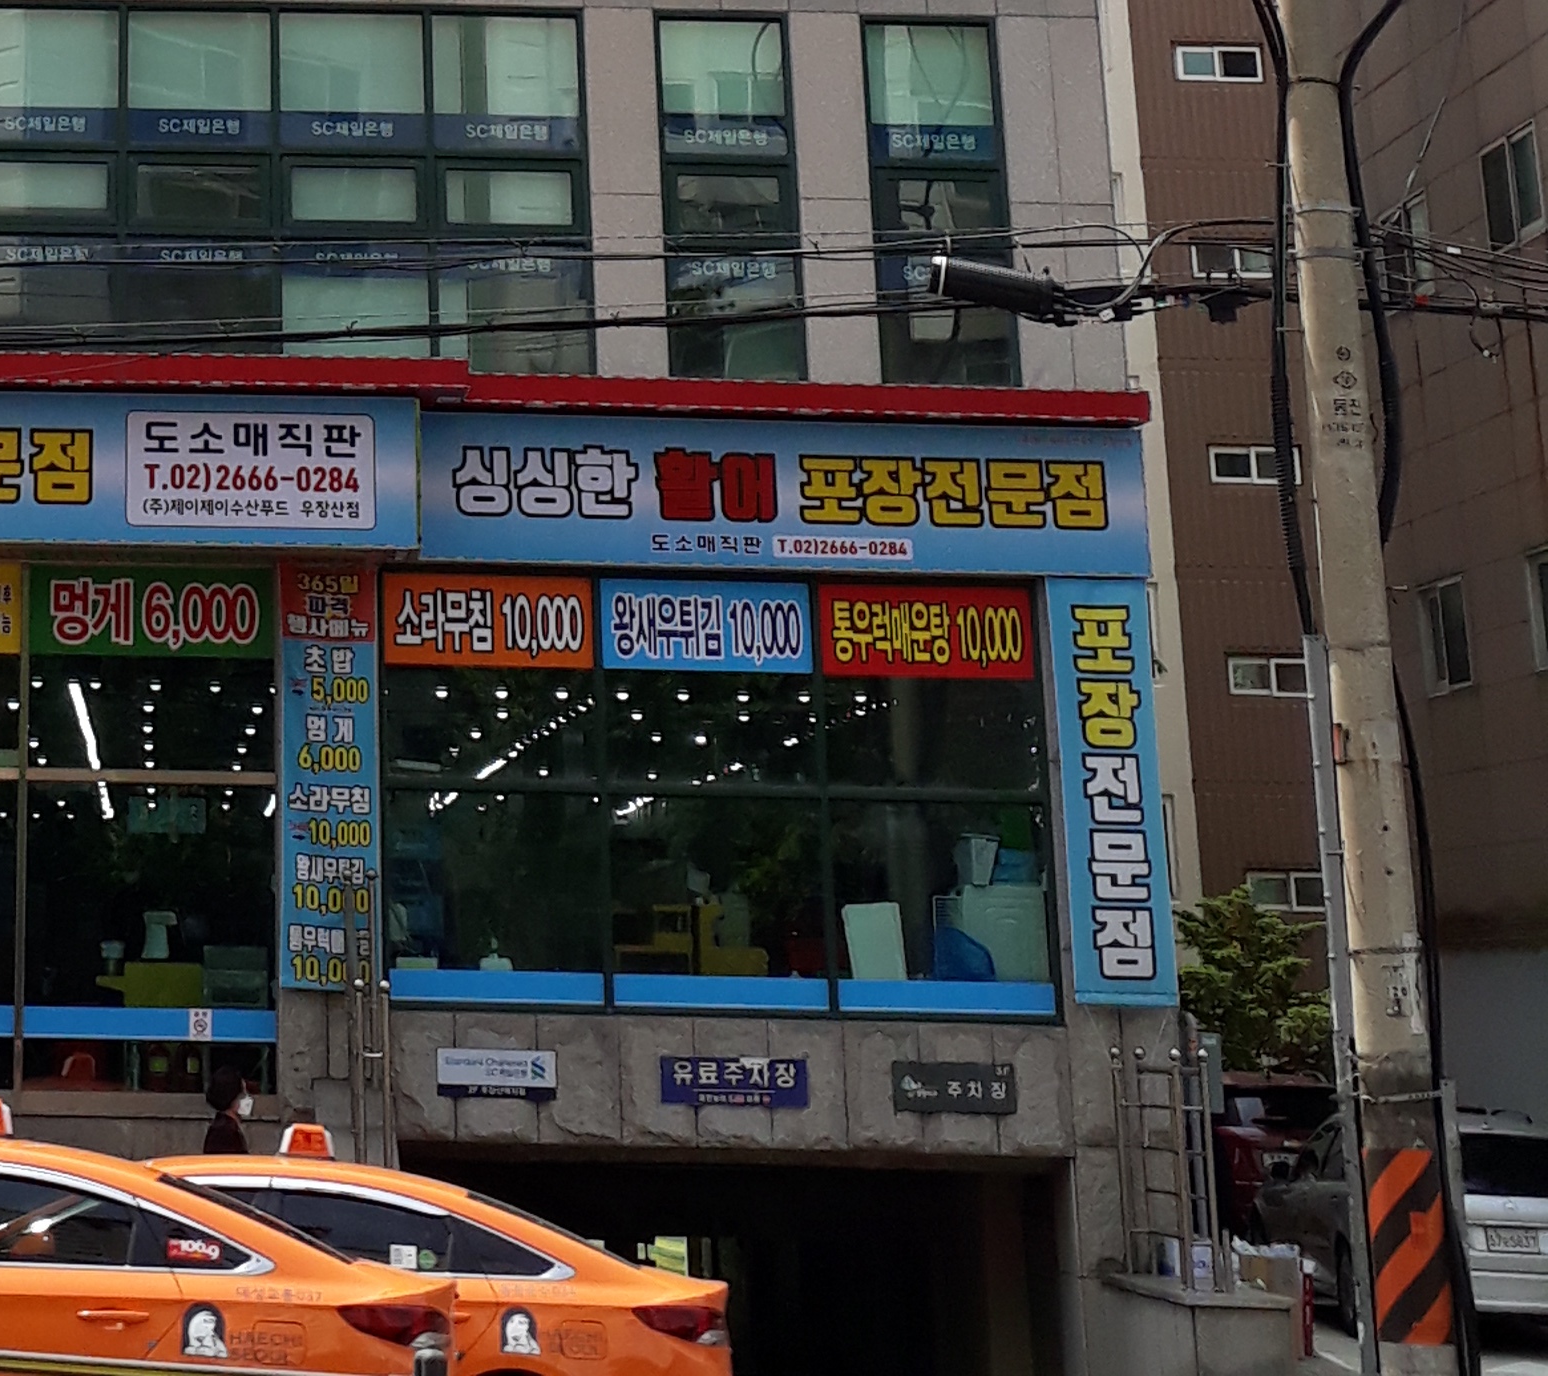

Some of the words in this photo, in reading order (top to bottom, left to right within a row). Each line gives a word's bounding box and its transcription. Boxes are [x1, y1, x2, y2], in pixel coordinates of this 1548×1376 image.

[4, 116, 87, 133] SC제일은행
[158, 117, 241, 134] SC제일은행
[310, 121, 394, 139] SC제일은행
[464, 123, 549, 141] SC제일은행
[683, 128, 770, 146] SC제일은행
[891, 132, 977, 151] SC제일은행
[144, 421, 363, 459] 도소매직판
[144, 462, 360, 494] T.02)2666-0284
[453, 444, 641, 520] 싱싱한
[654, 446, 779, 524] 활어
[798, 454, 1110, 531] 포장전문점
[142, 497, 290, 518] (주)제이제이수산푸드
[299, 499, 361, 520] 우장산점
[652, 533, 764, 555] 도소매직판
[777, 538, 909, 557] T.02)2666-0284
[52, 578, 135, 645] 멍게
[142, 583, 259, 650] 6,000
[395, 589, 494, 653] 소라무침
[500, 593, 585, 660] 10,000
[610, 592, 725, 661] 왕새우튀김
[726, 598, 803, 666] 10,000
[831, 599, 951, 665] 통우럭매운탕
[954, 605, 1023, 669] 10,000
[311, 675, 370, 709] 5,000
[298, 744, 362, 774] 6,000
[288, 782, 371, 815] 소라무침
[1070, 603, 1157, 981] 포장전문점
[308, 817, 371, 850] 10,000
[292, 883, 370, 916] 10,00
[291, 954, 370, 987] 10,00
[672, 1060, 797, 1089] 유료주차장
